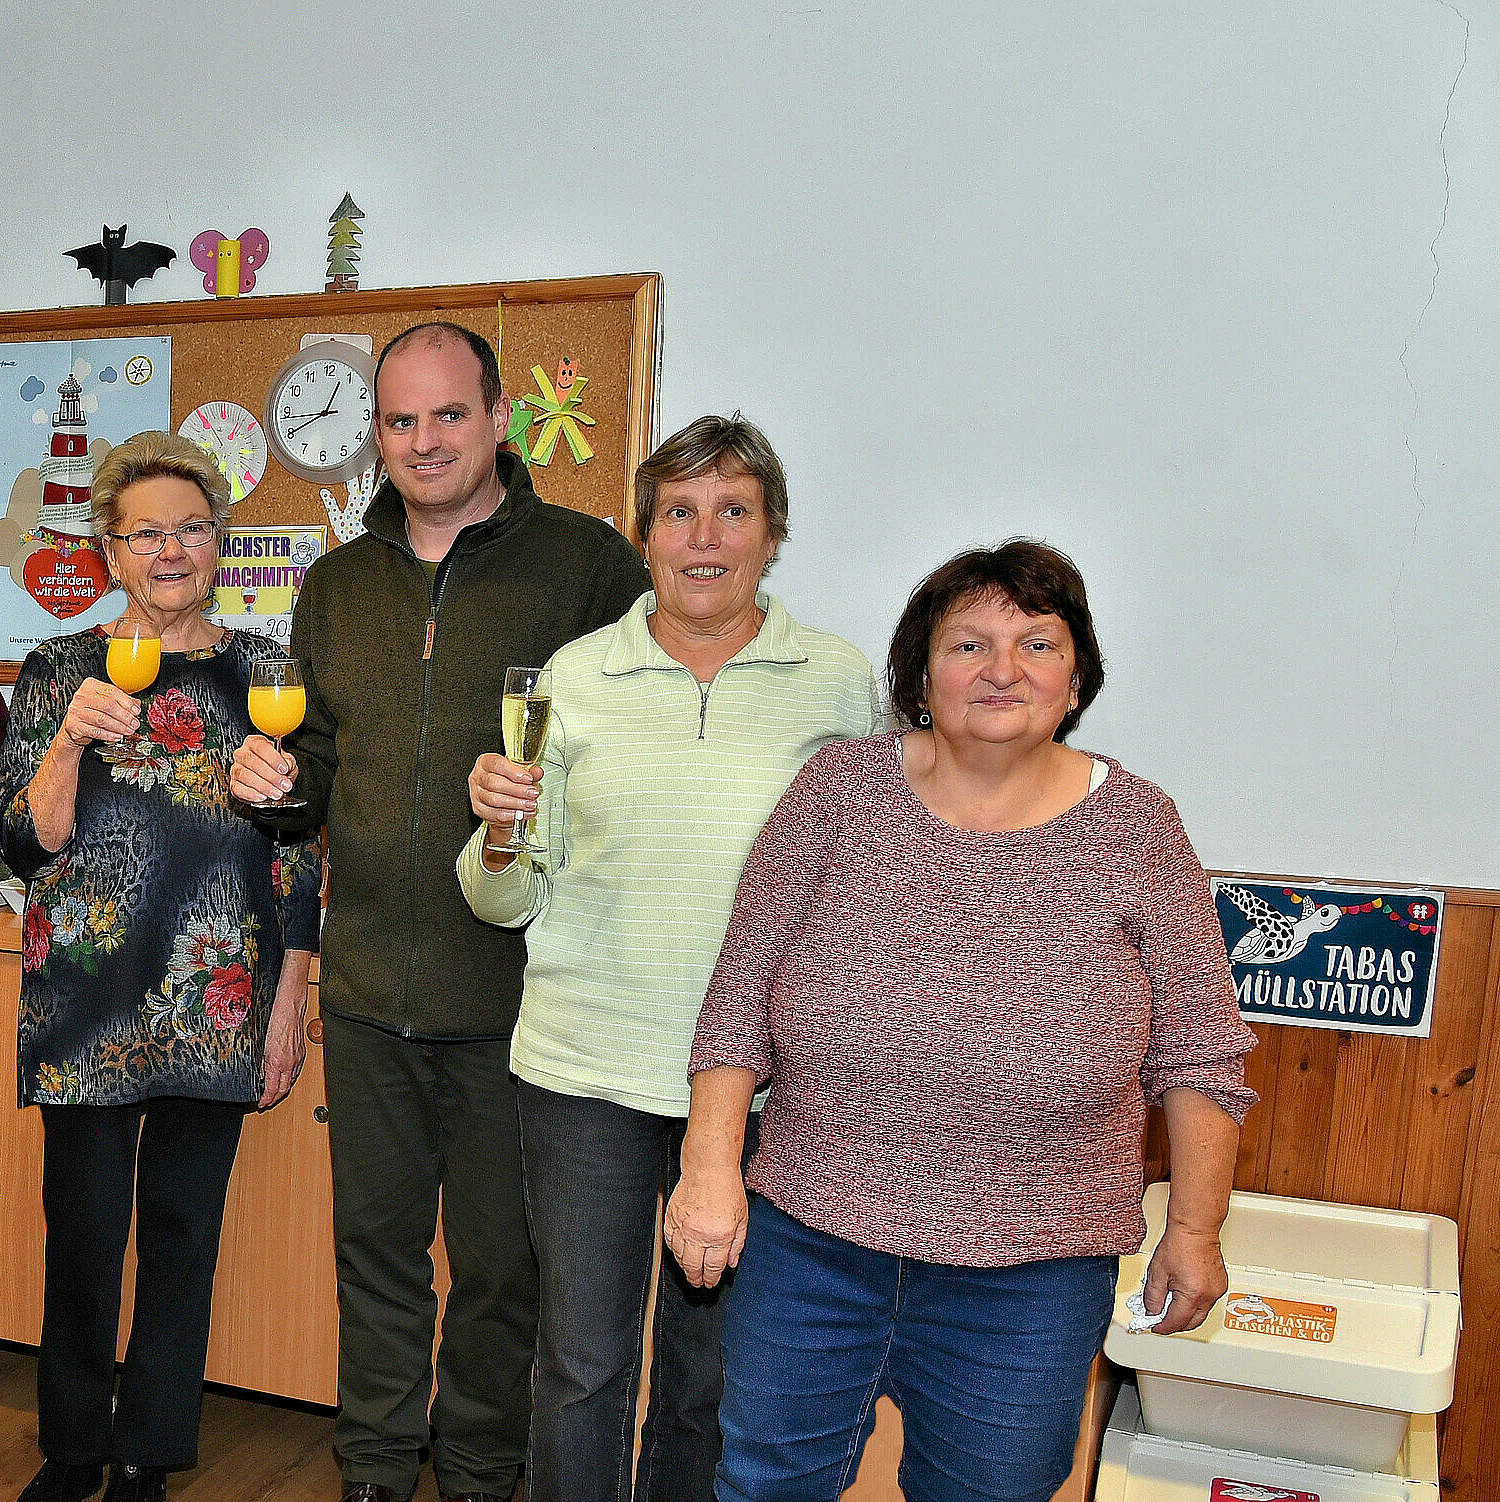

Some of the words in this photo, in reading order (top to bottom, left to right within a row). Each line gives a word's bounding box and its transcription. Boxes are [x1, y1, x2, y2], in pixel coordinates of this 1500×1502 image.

[305, 371, 315, 382] 11
[324, 365, 336, 376] 12
[347, 372, 352, 384] 1
[290, 385, 301, 397] 10
[360, 387, 367, 399] 2
[284, 406, 290, 418] 9
[363, 409, 370, 421] 3
[288, 427, 294, 439] 8
[355, 431, 363, 442] 4
[302, 443, 308, 454] 7
[340, 445, 348, 456] 5
[320, 450, 326, 462] 6
[218, 533, 290, 557] ÄCHSTER
[55, 562, 77, 574] Hier
[38, 574, 93, 586] verändern
[34, 586, 52, 596] wir
[53, 586, 70, 597] die
[72, 586, 96, 598] Welt
[1324, 945, 1416, 984] TABAS
[1270, 1315, 1333, 1332] PLASTIK-
[1228, 1318, 1292, 1337] FLASCHEN
[1297, 1329, 1308, 1339] &
[1312, 1331, 1330, 1342] CO
